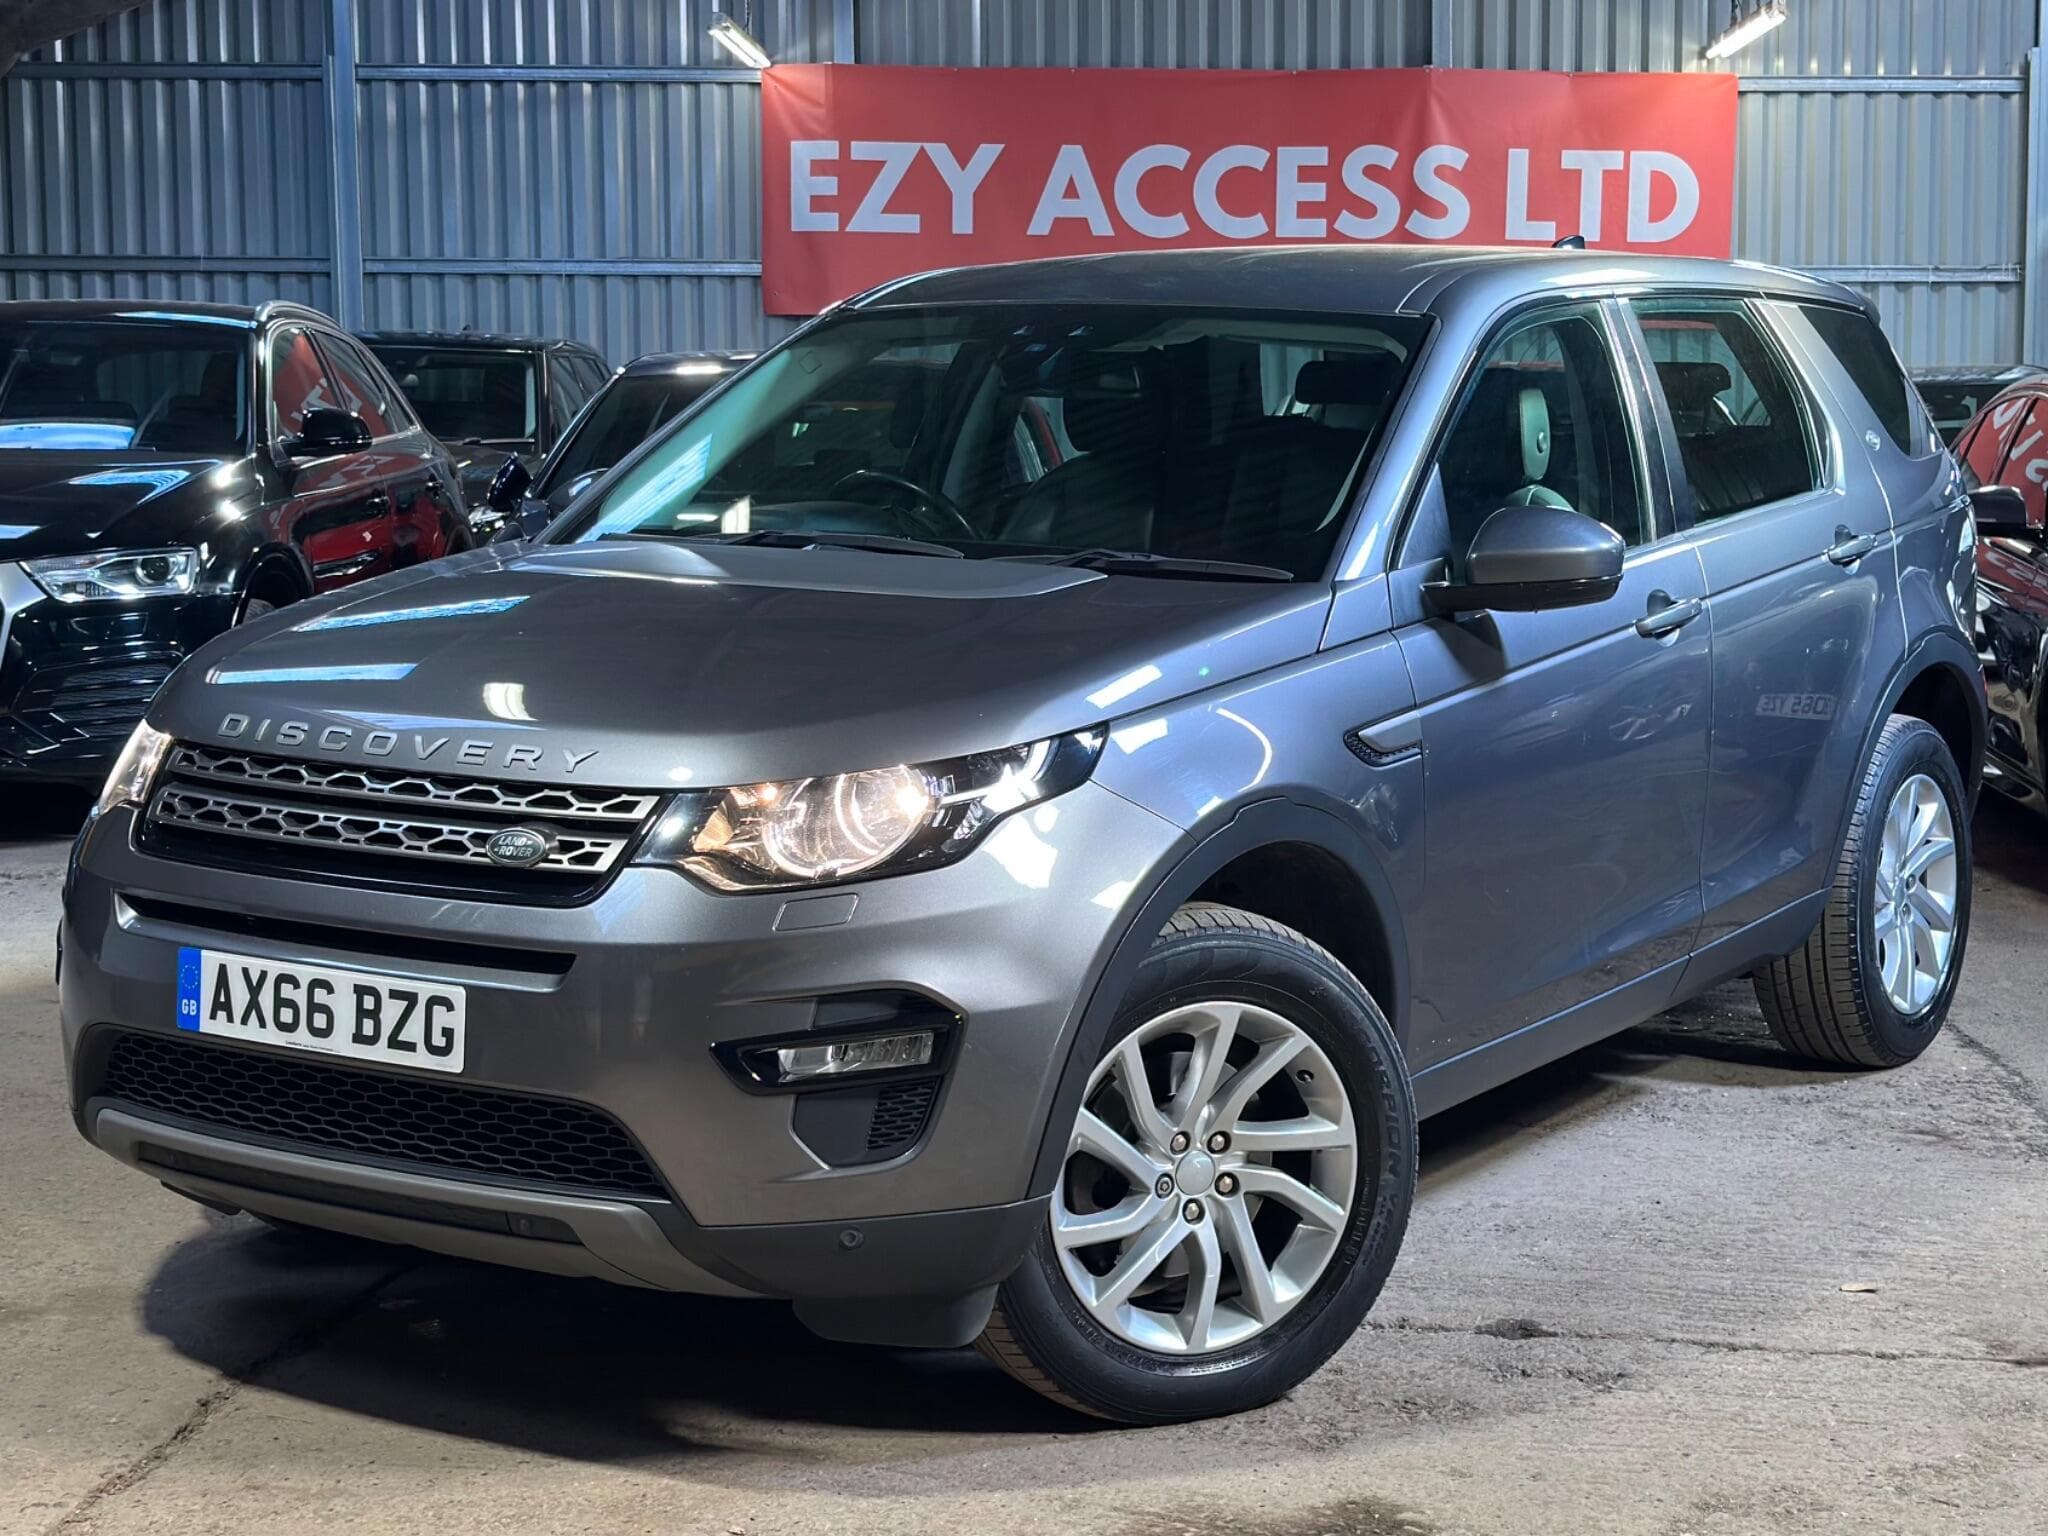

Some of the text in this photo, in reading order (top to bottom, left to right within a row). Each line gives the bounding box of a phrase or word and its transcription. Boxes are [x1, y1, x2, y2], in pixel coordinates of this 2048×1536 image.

[790, 140, 1699, 243] EZY ACCESS LTD
[217, 712, 599, 772] DISCOVERY
[498, 846, 533, 857] ROVER
[499, 836, 528, 846] LAND
[182, 999, 197, 1015] GB
[209, 963, 455, 1057] AX66 BZG
